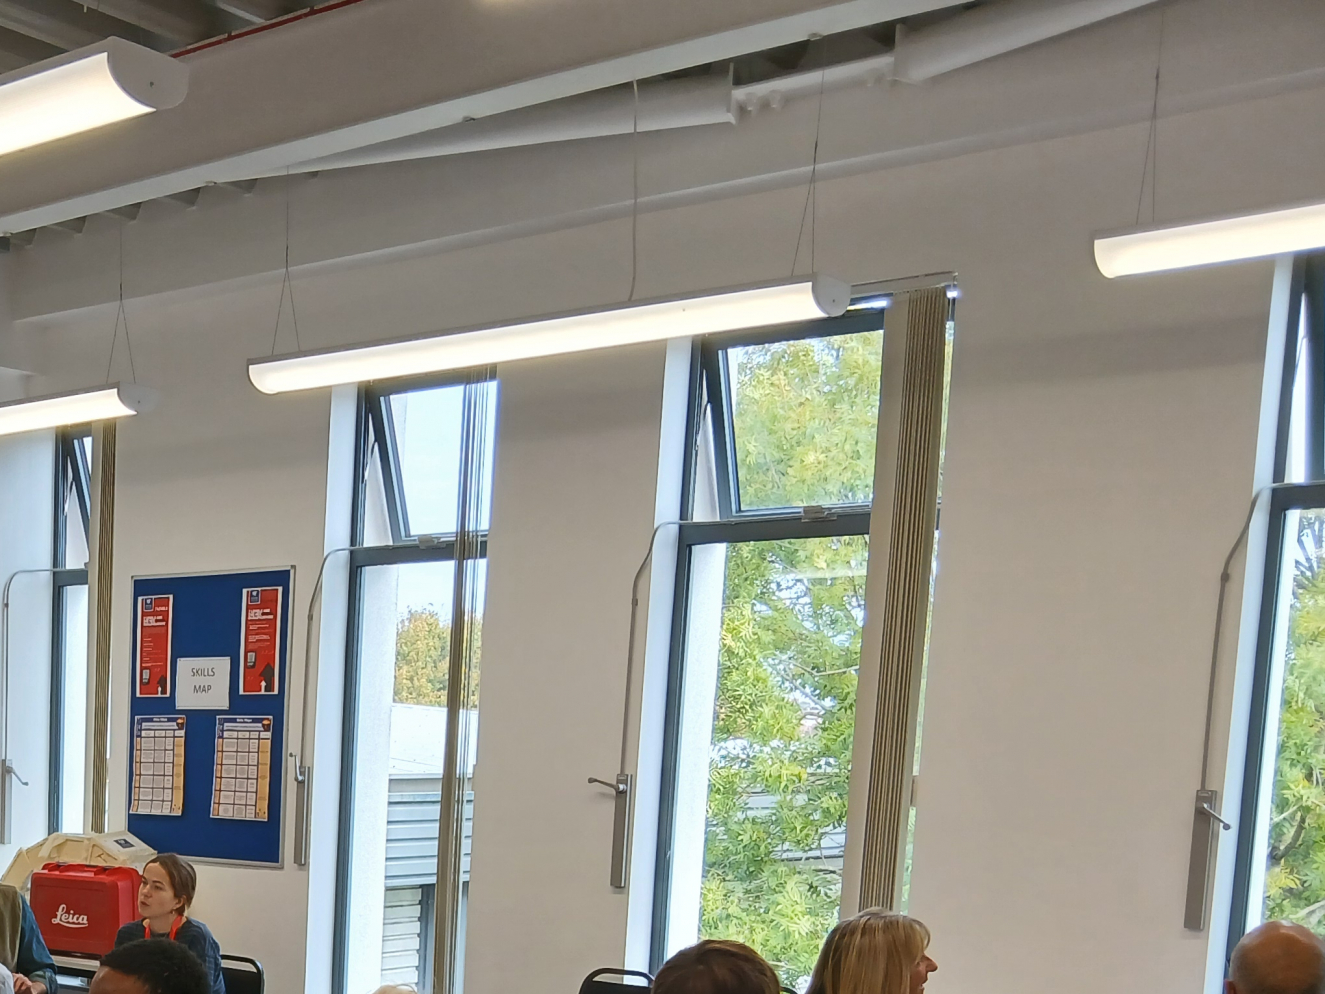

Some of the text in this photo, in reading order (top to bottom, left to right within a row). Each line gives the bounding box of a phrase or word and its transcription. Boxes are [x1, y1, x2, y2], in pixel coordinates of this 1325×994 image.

[191, 667, 216, 677] SKILLS
[193, 684, 212, 694] MAP
[51, 903, 89, 928] Leica
